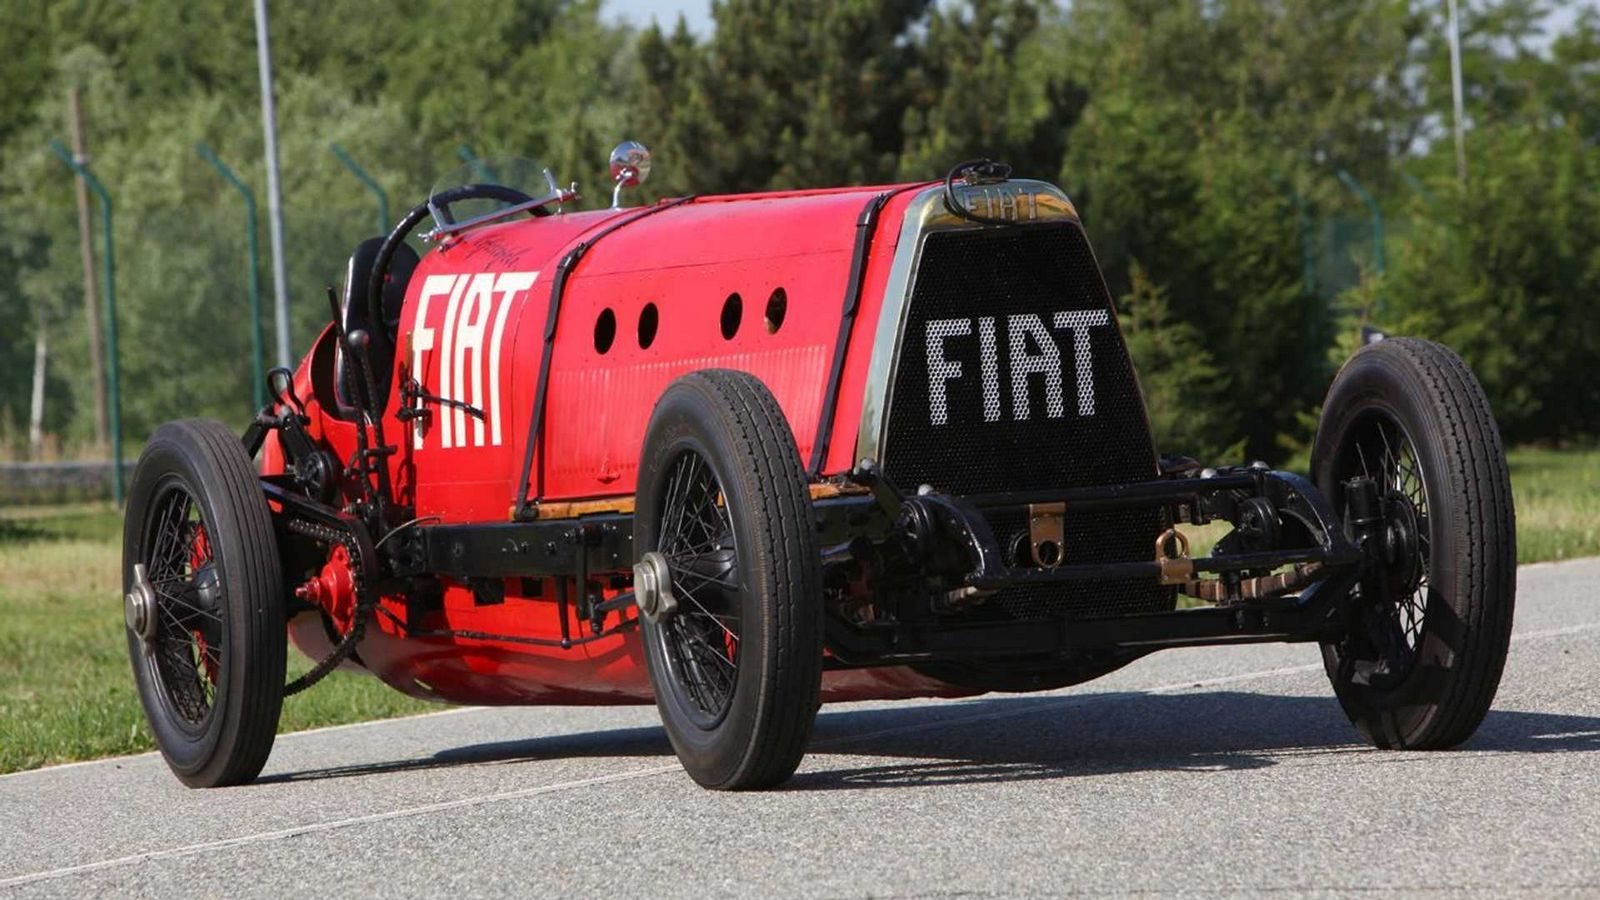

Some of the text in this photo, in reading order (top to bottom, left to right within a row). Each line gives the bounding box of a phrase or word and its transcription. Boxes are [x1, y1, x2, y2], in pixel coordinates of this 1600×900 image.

[964, 187, 1042, 221] FIAT
[412, 271, 540, 450] FIAT
[925, 309, 1109, 426] FIAT
